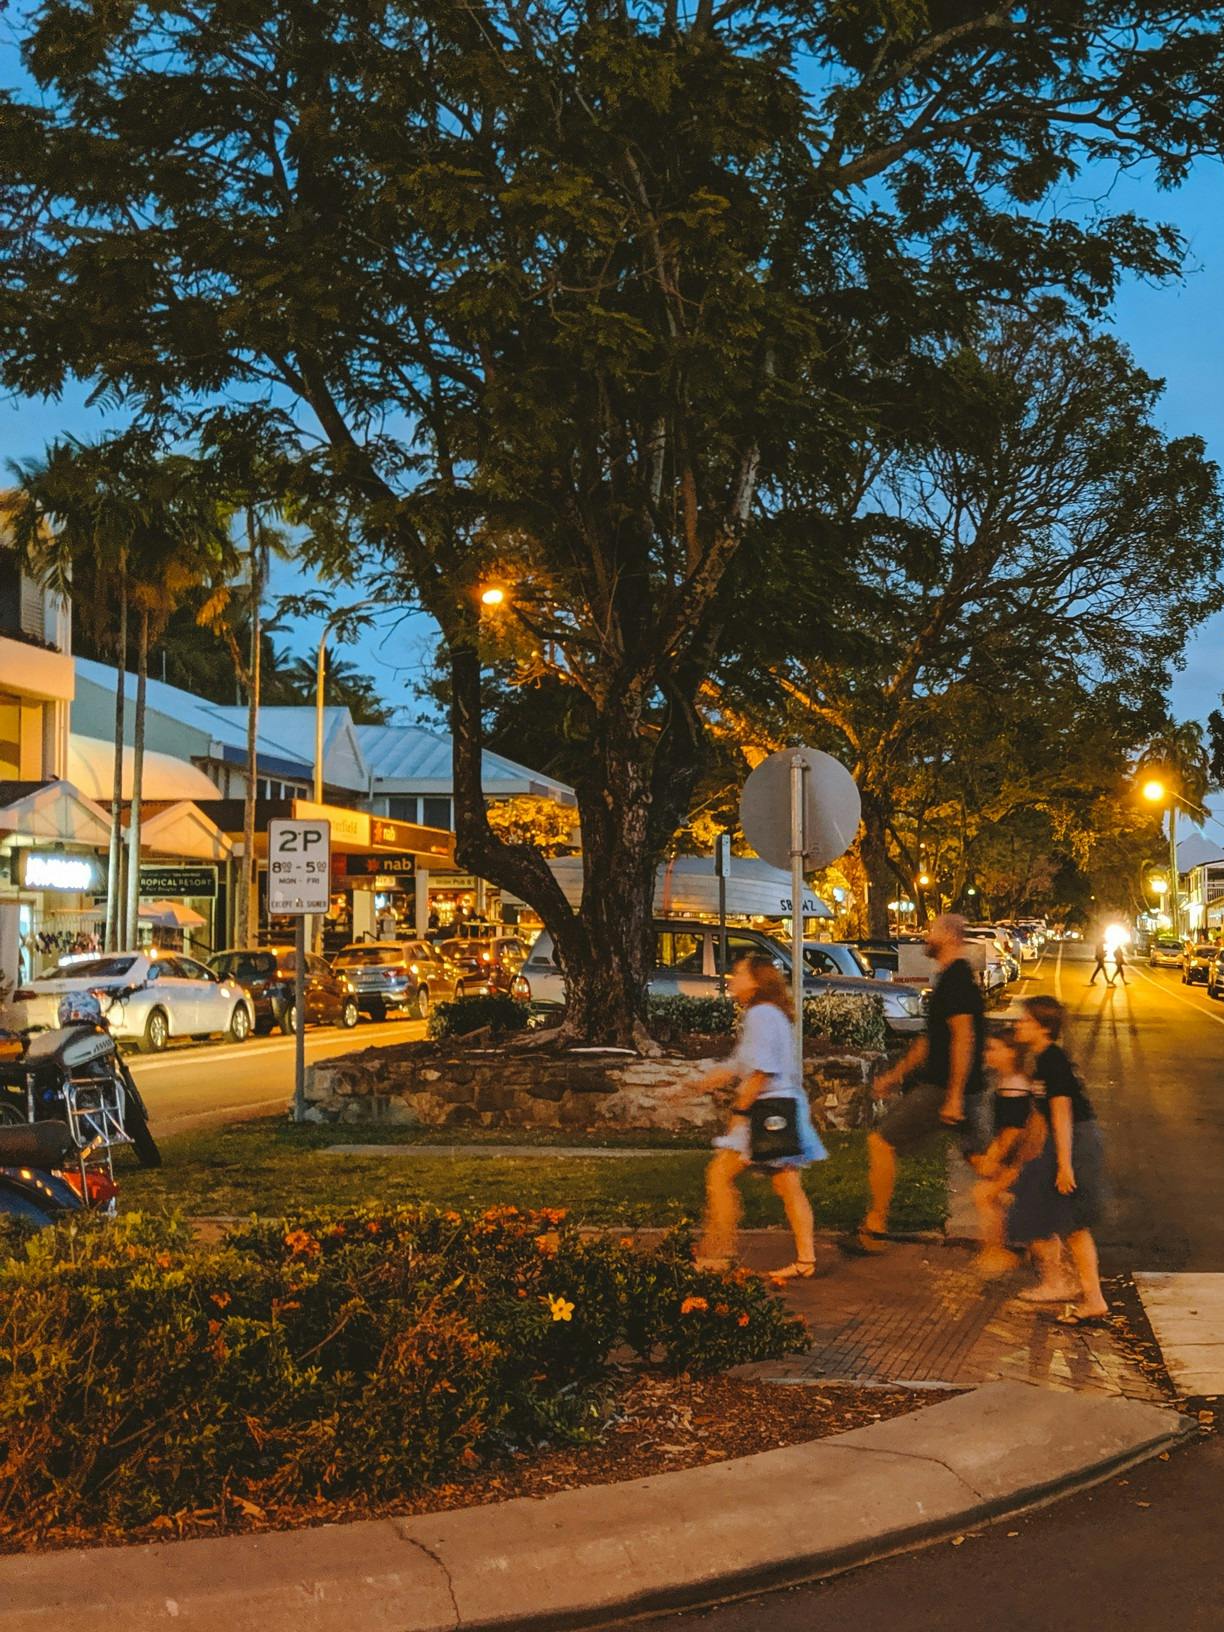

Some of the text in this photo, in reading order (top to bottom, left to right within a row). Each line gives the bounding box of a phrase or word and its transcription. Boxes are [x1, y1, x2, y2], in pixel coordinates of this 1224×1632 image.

[278, 830, 322, 852] 2P
[383, 858, 412, 871] nab
[140, 879, 212, 887] ROPICAL RESORT
[278, 877, 297, 885] MON
[306, 877, 320, 885] FRI
